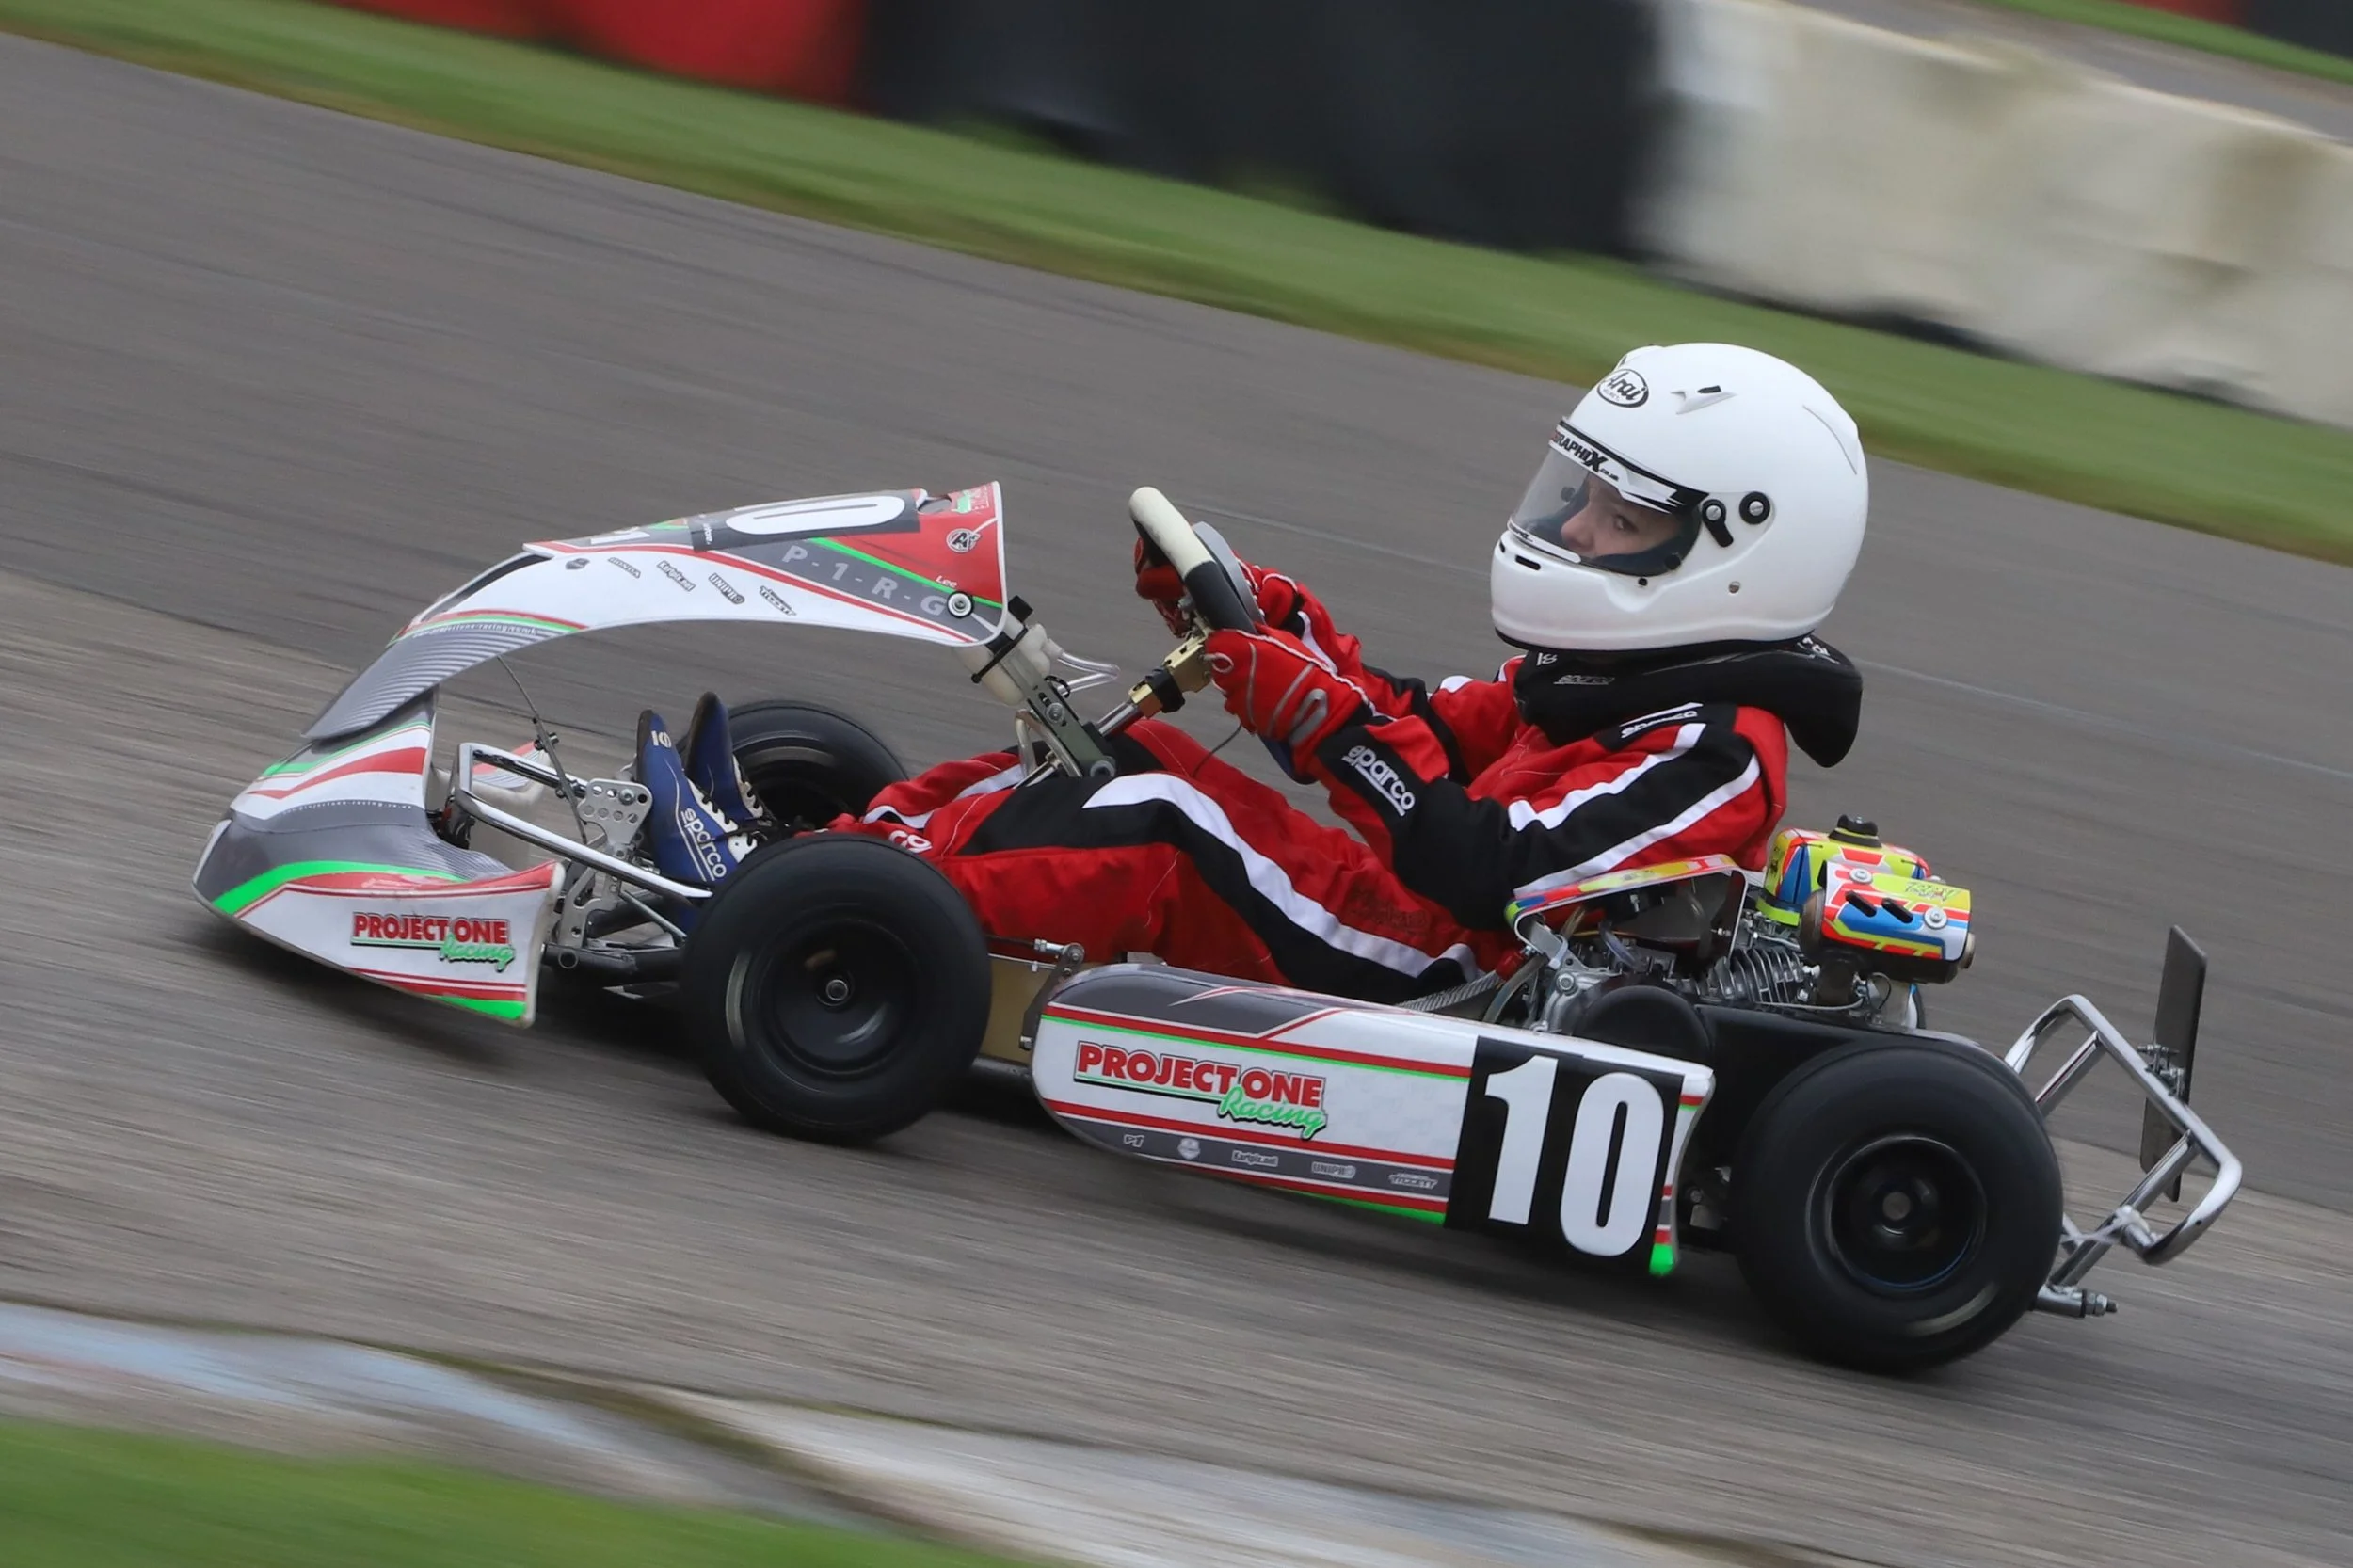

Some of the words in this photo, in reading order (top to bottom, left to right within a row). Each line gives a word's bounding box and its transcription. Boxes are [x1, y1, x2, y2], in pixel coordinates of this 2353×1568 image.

[1607, 372, 1646, 401] Arai
[936, 575, 958, 589] Lee
[681, 808, 728, 882] sparco
[353, 914, 451, 943] PROJECT
[453, 919, 508, 945] ONE
[1077, 1043, 1239, 1095] PROJECT
[1241, 1068, 1323, 1108] ONE
[1220, 1084, 1327, 1140] Racing
[1484, 1055, 1665, 1256] 10
